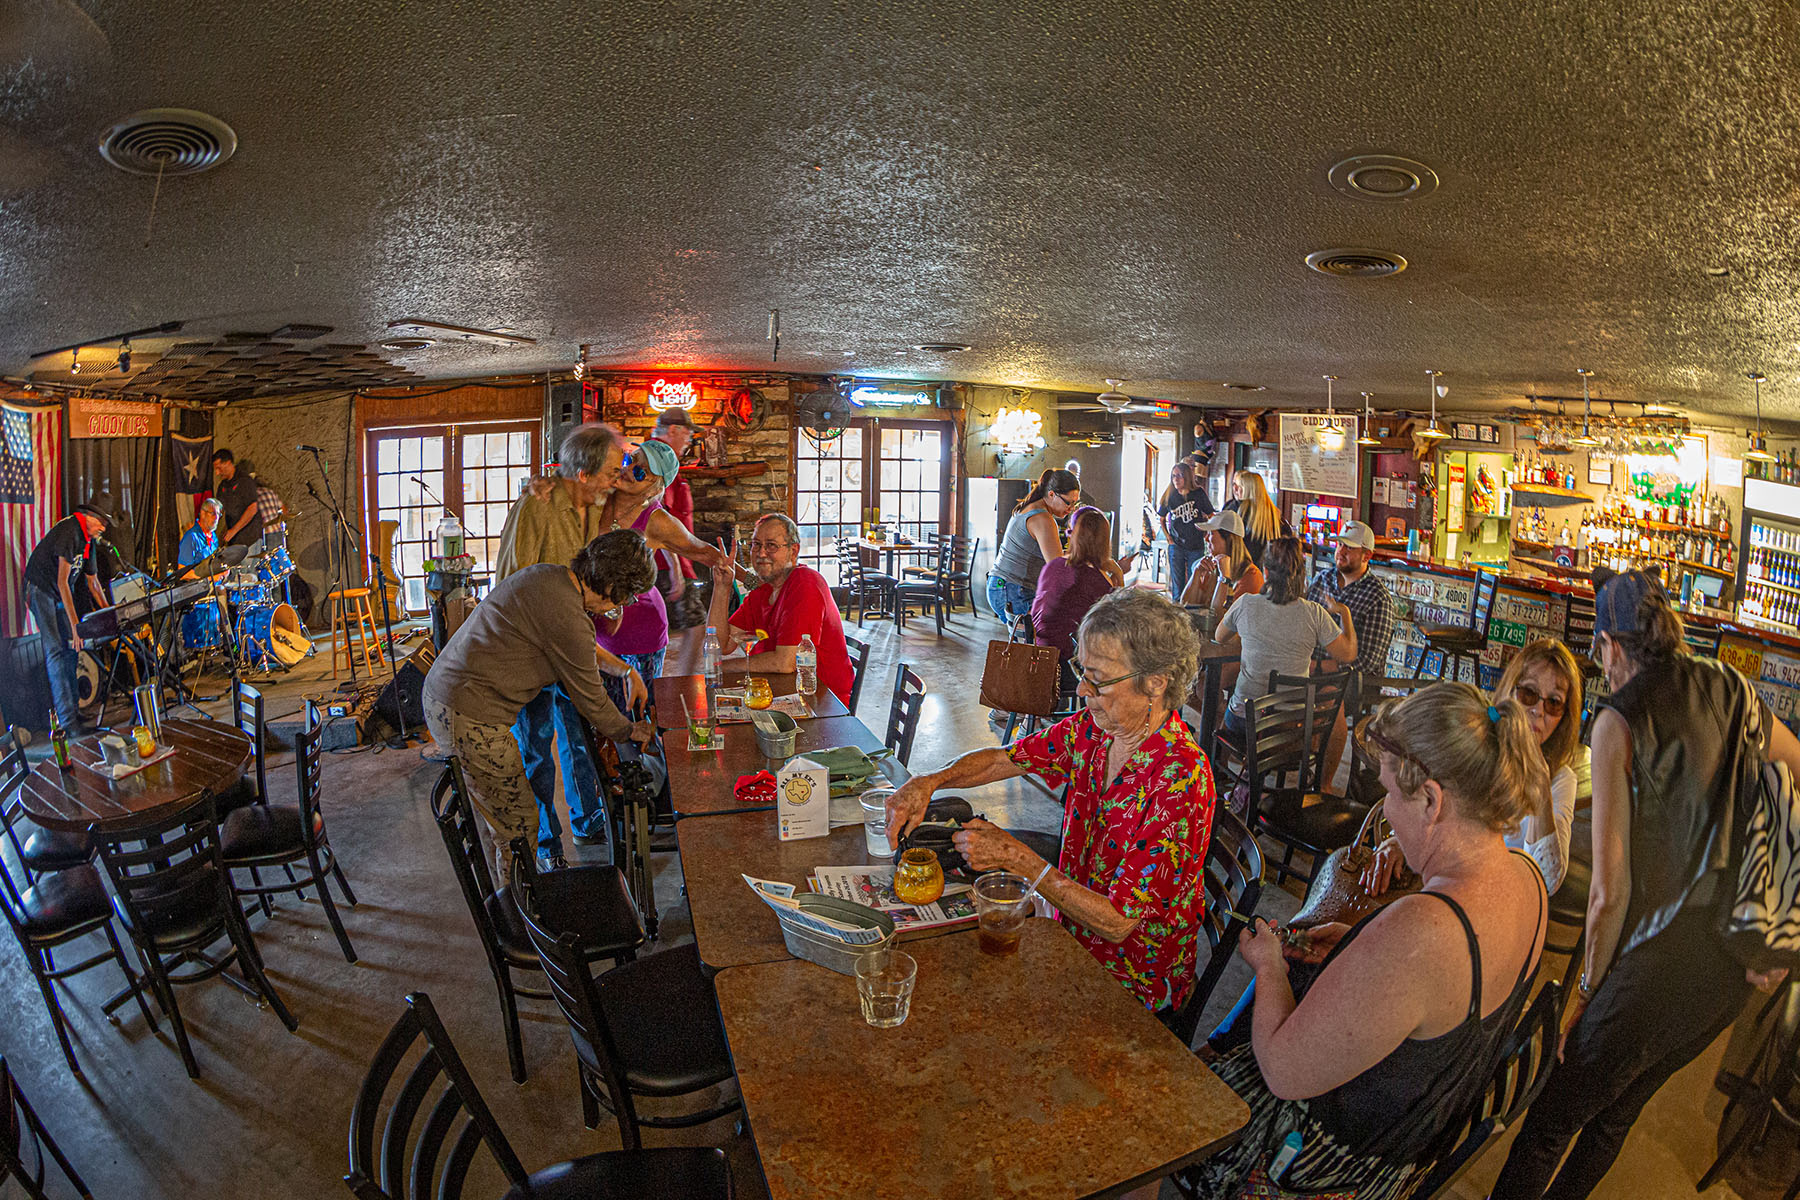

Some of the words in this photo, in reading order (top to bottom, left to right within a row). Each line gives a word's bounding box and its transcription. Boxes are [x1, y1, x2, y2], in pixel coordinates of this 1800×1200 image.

[652, 379, 694, 395] Coors
[655, 394, 691, 404] LIGHT
[88, 415, 125, 436] GIDDY
[127, 416, 149, 435] UPS
[1284, 432, 1304, 441] HAPPY
[1503, 626, 1524, 643] 7495
[780, 778, 790, 789] ALL
